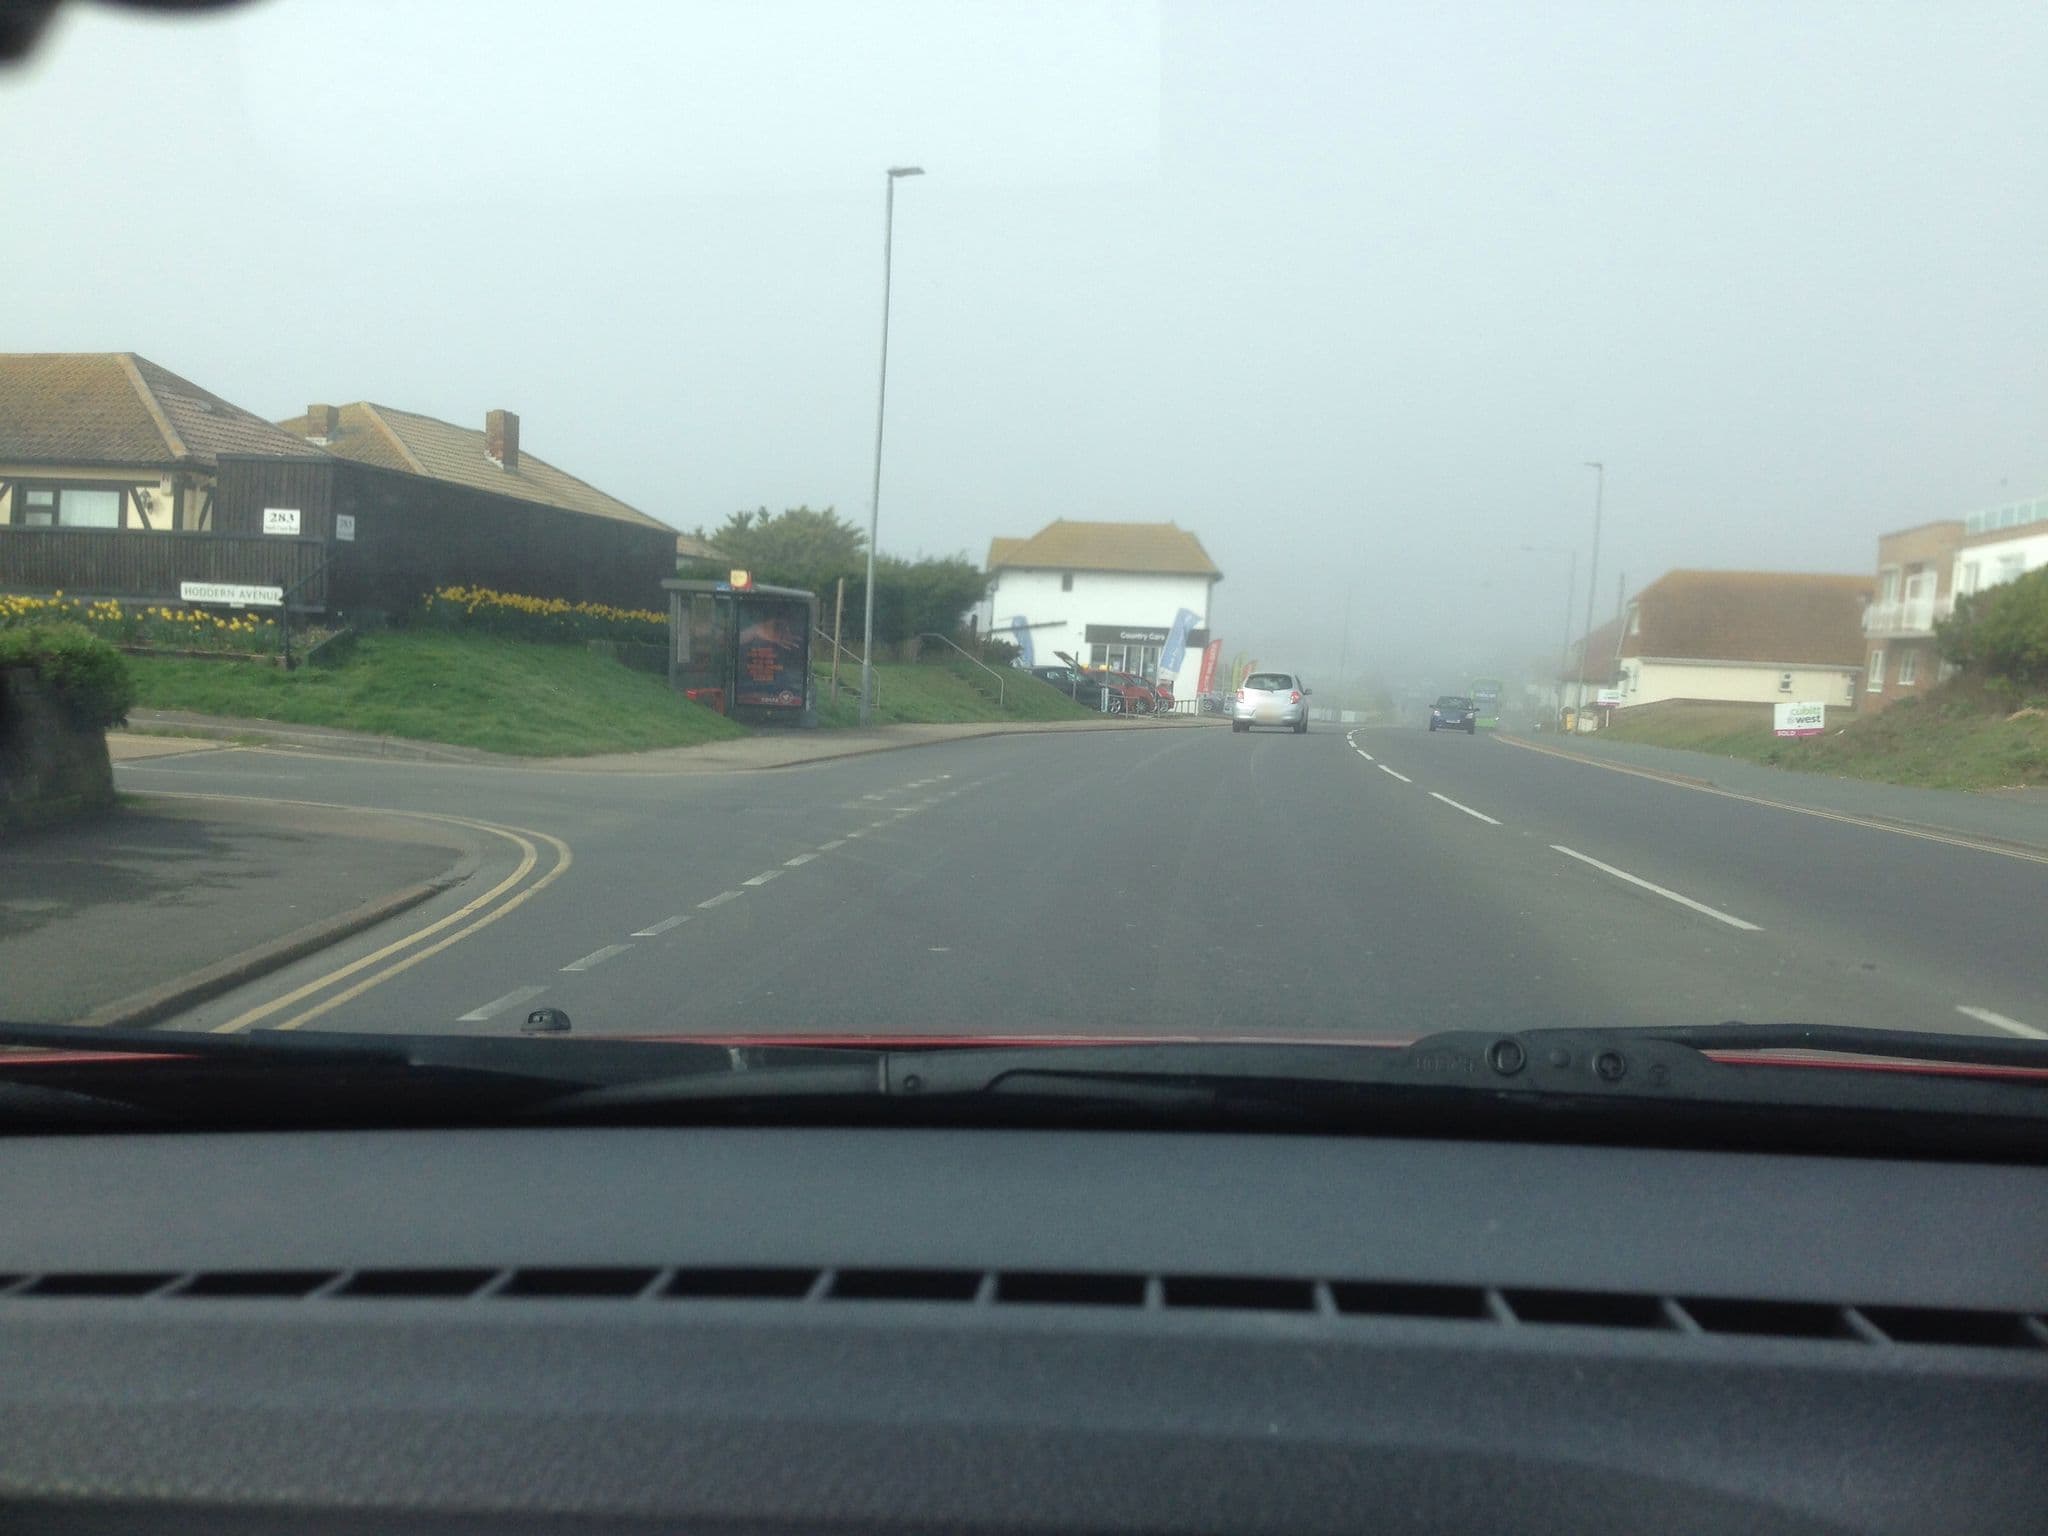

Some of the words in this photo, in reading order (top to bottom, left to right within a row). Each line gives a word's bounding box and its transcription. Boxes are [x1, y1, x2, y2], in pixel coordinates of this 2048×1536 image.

[184, 586, 235, 598] HODDERN
[239, 589, 281, 601] AVENUE
[1120, 631, 1148, 641] Country
